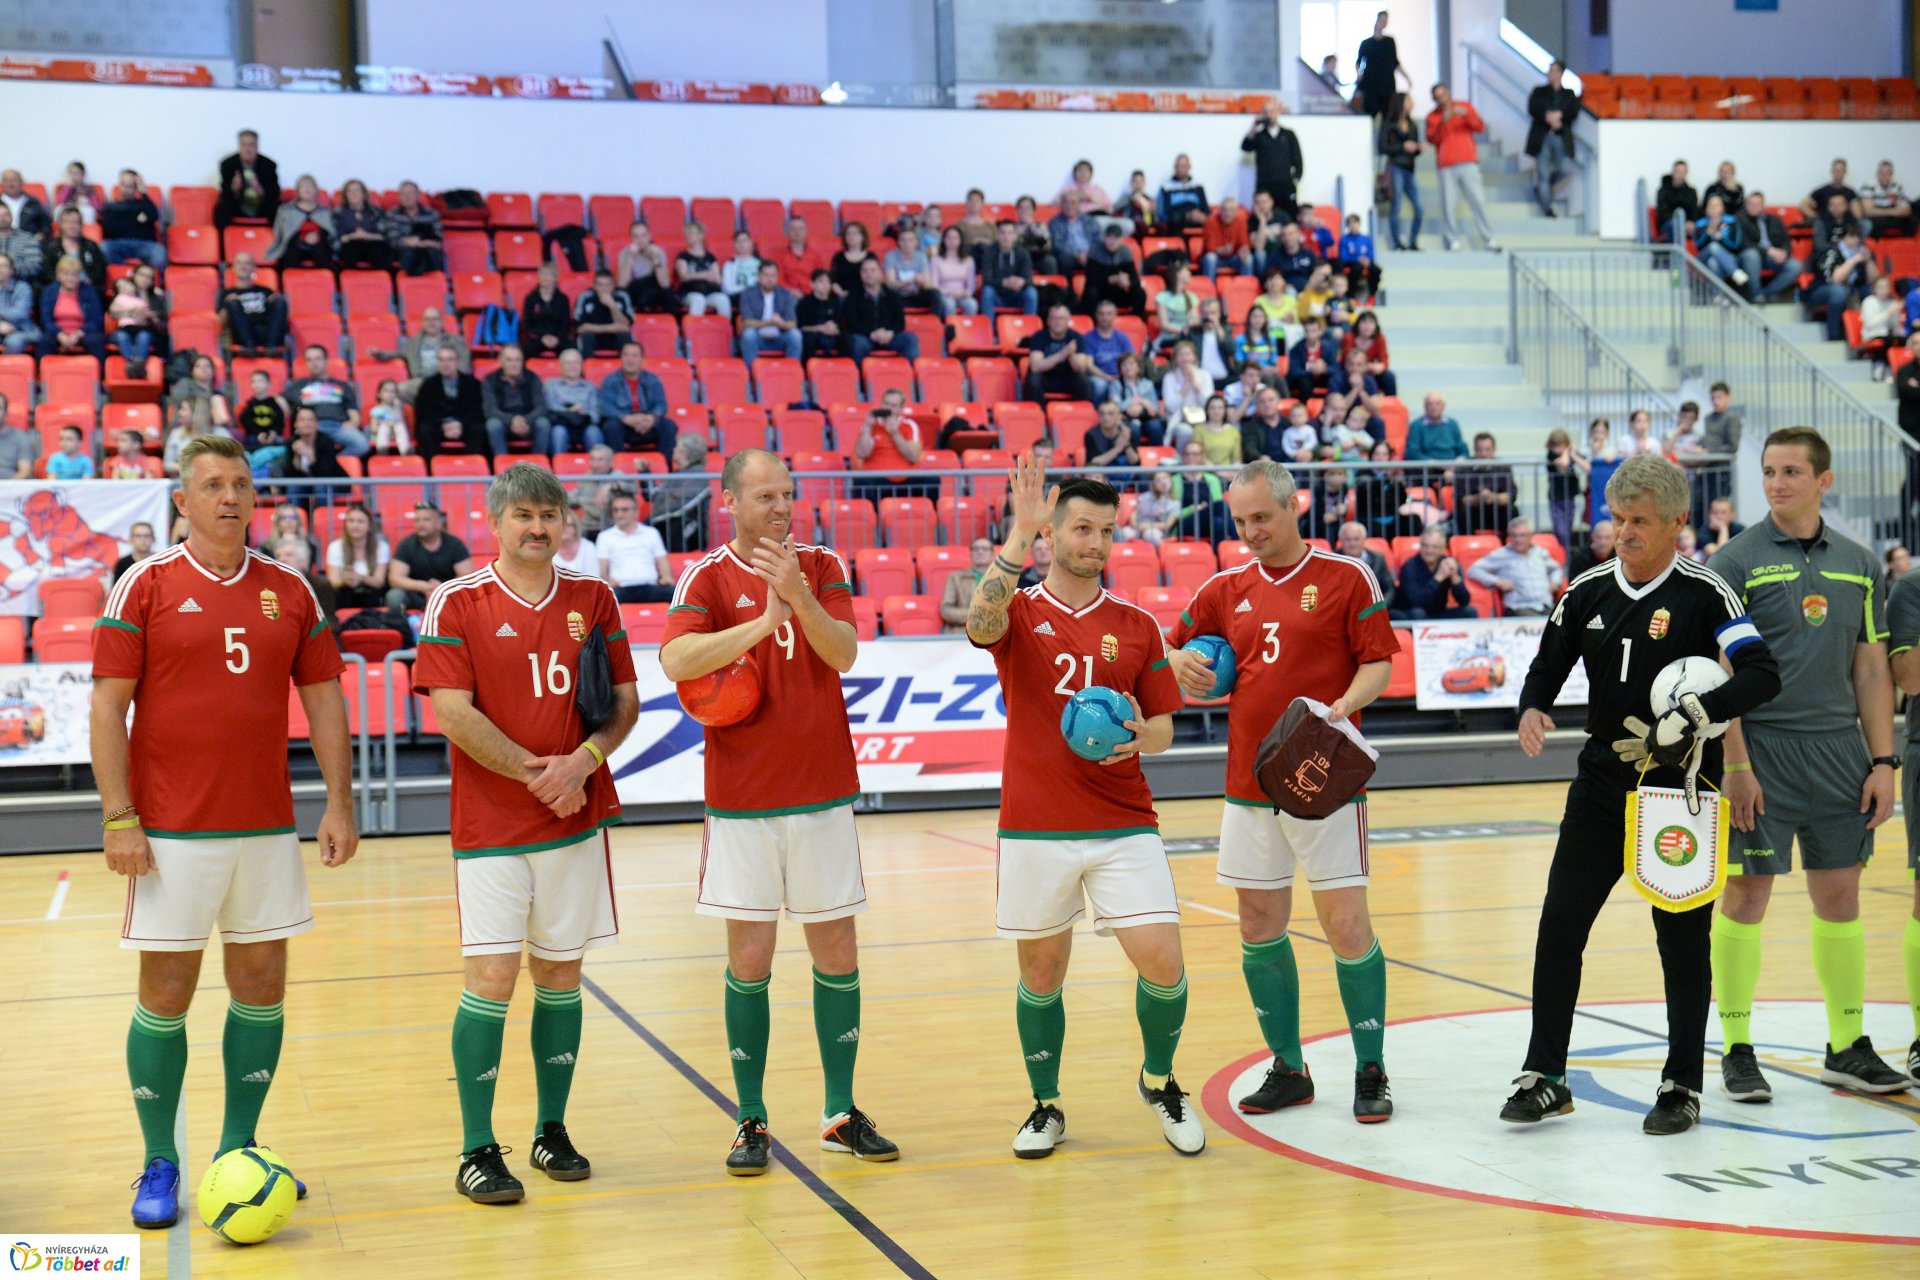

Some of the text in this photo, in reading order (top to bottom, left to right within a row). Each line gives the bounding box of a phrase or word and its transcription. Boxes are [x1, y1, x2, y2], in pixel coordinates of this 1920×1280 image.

[224, 627, 250, 674] 5
[774, 620, 795, 661] 9
[1033, 627, 1056, 637] adidas
[1262, 622, 1280, 663] 3
[528, 651, 571, 698] 16
[1054, 653, 1094, 696] 21
[1620, 638, 1632, 683] 1
[1687, 701, 1703, 723] DIDA
[1317, 759, 1331, 769] 40
[1283, 778, 1312, 803] KIPSTA
